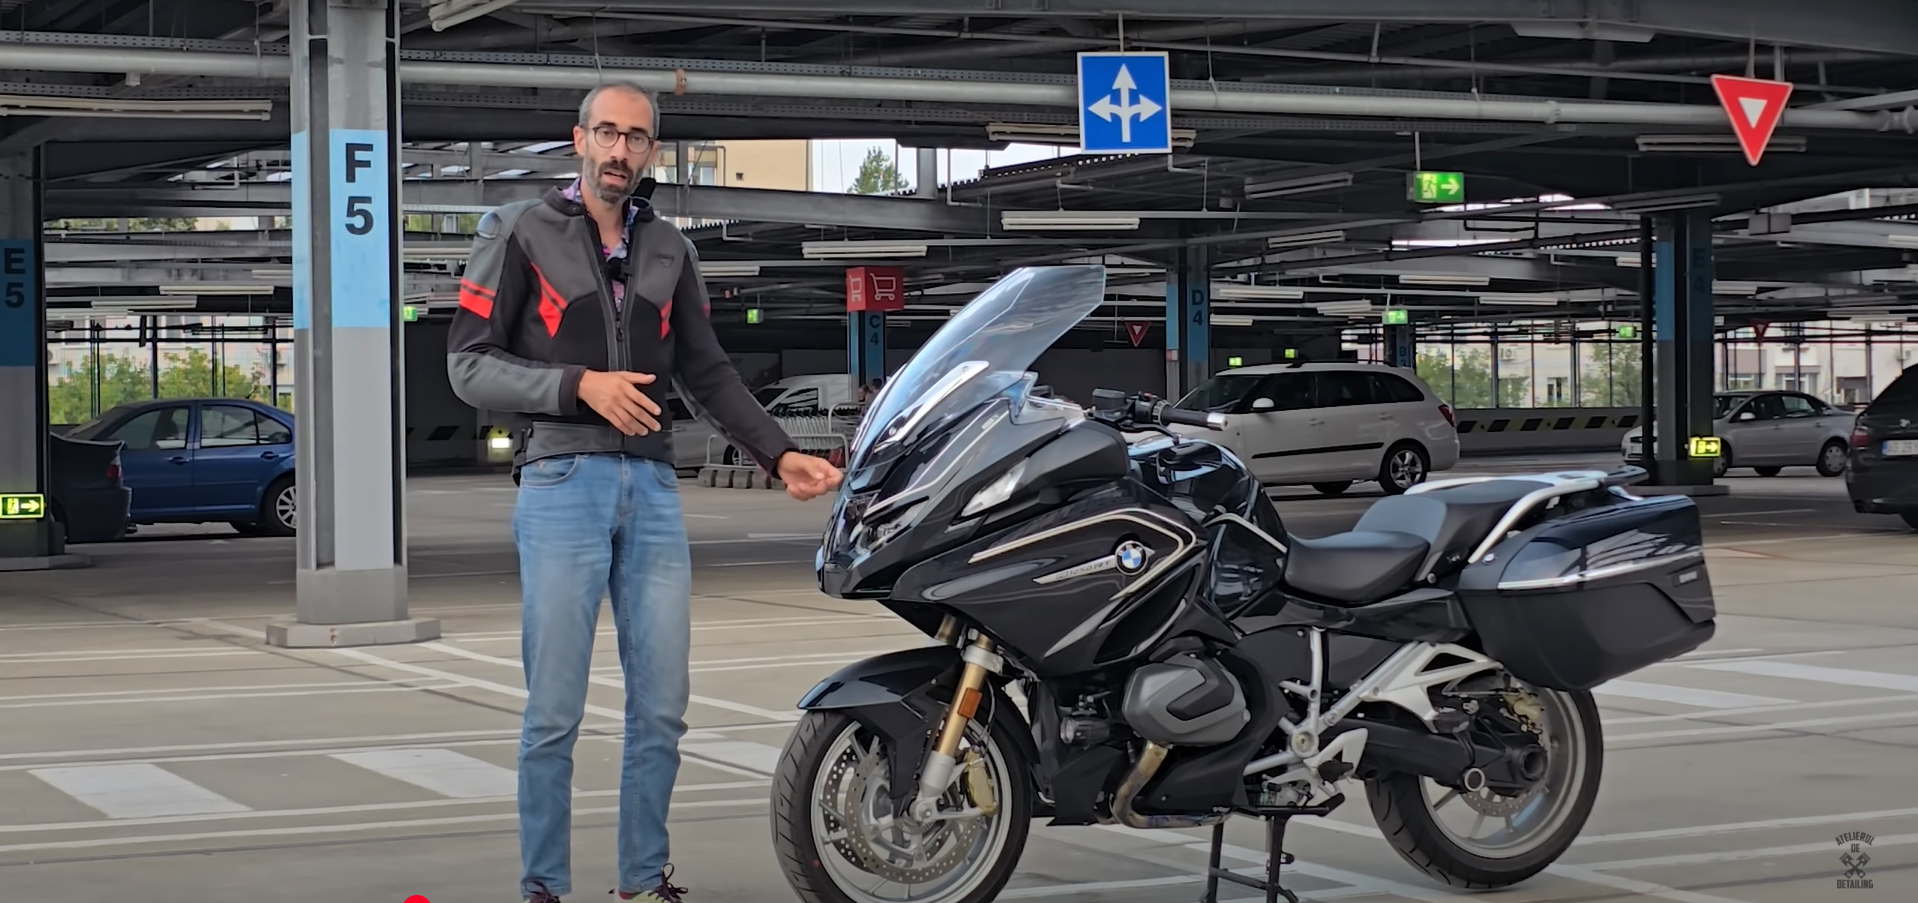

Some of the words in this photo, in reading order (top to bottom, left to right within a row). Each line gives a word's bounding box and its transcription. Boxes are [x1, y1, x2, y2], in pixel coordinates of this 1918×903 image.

[344, 142, 374, 183] F
[344, 195, 375, 236] 5
[4, 247, 26, 275] E
[1692, 247, 1707, 269] E
[4, 282, 25, 309] 5
[1191, 289, 1205, 306] D
[869, 314, 881, 329] C
[1192, 309, 1204, 326] 4
[869, 332, 880, 346] 4
